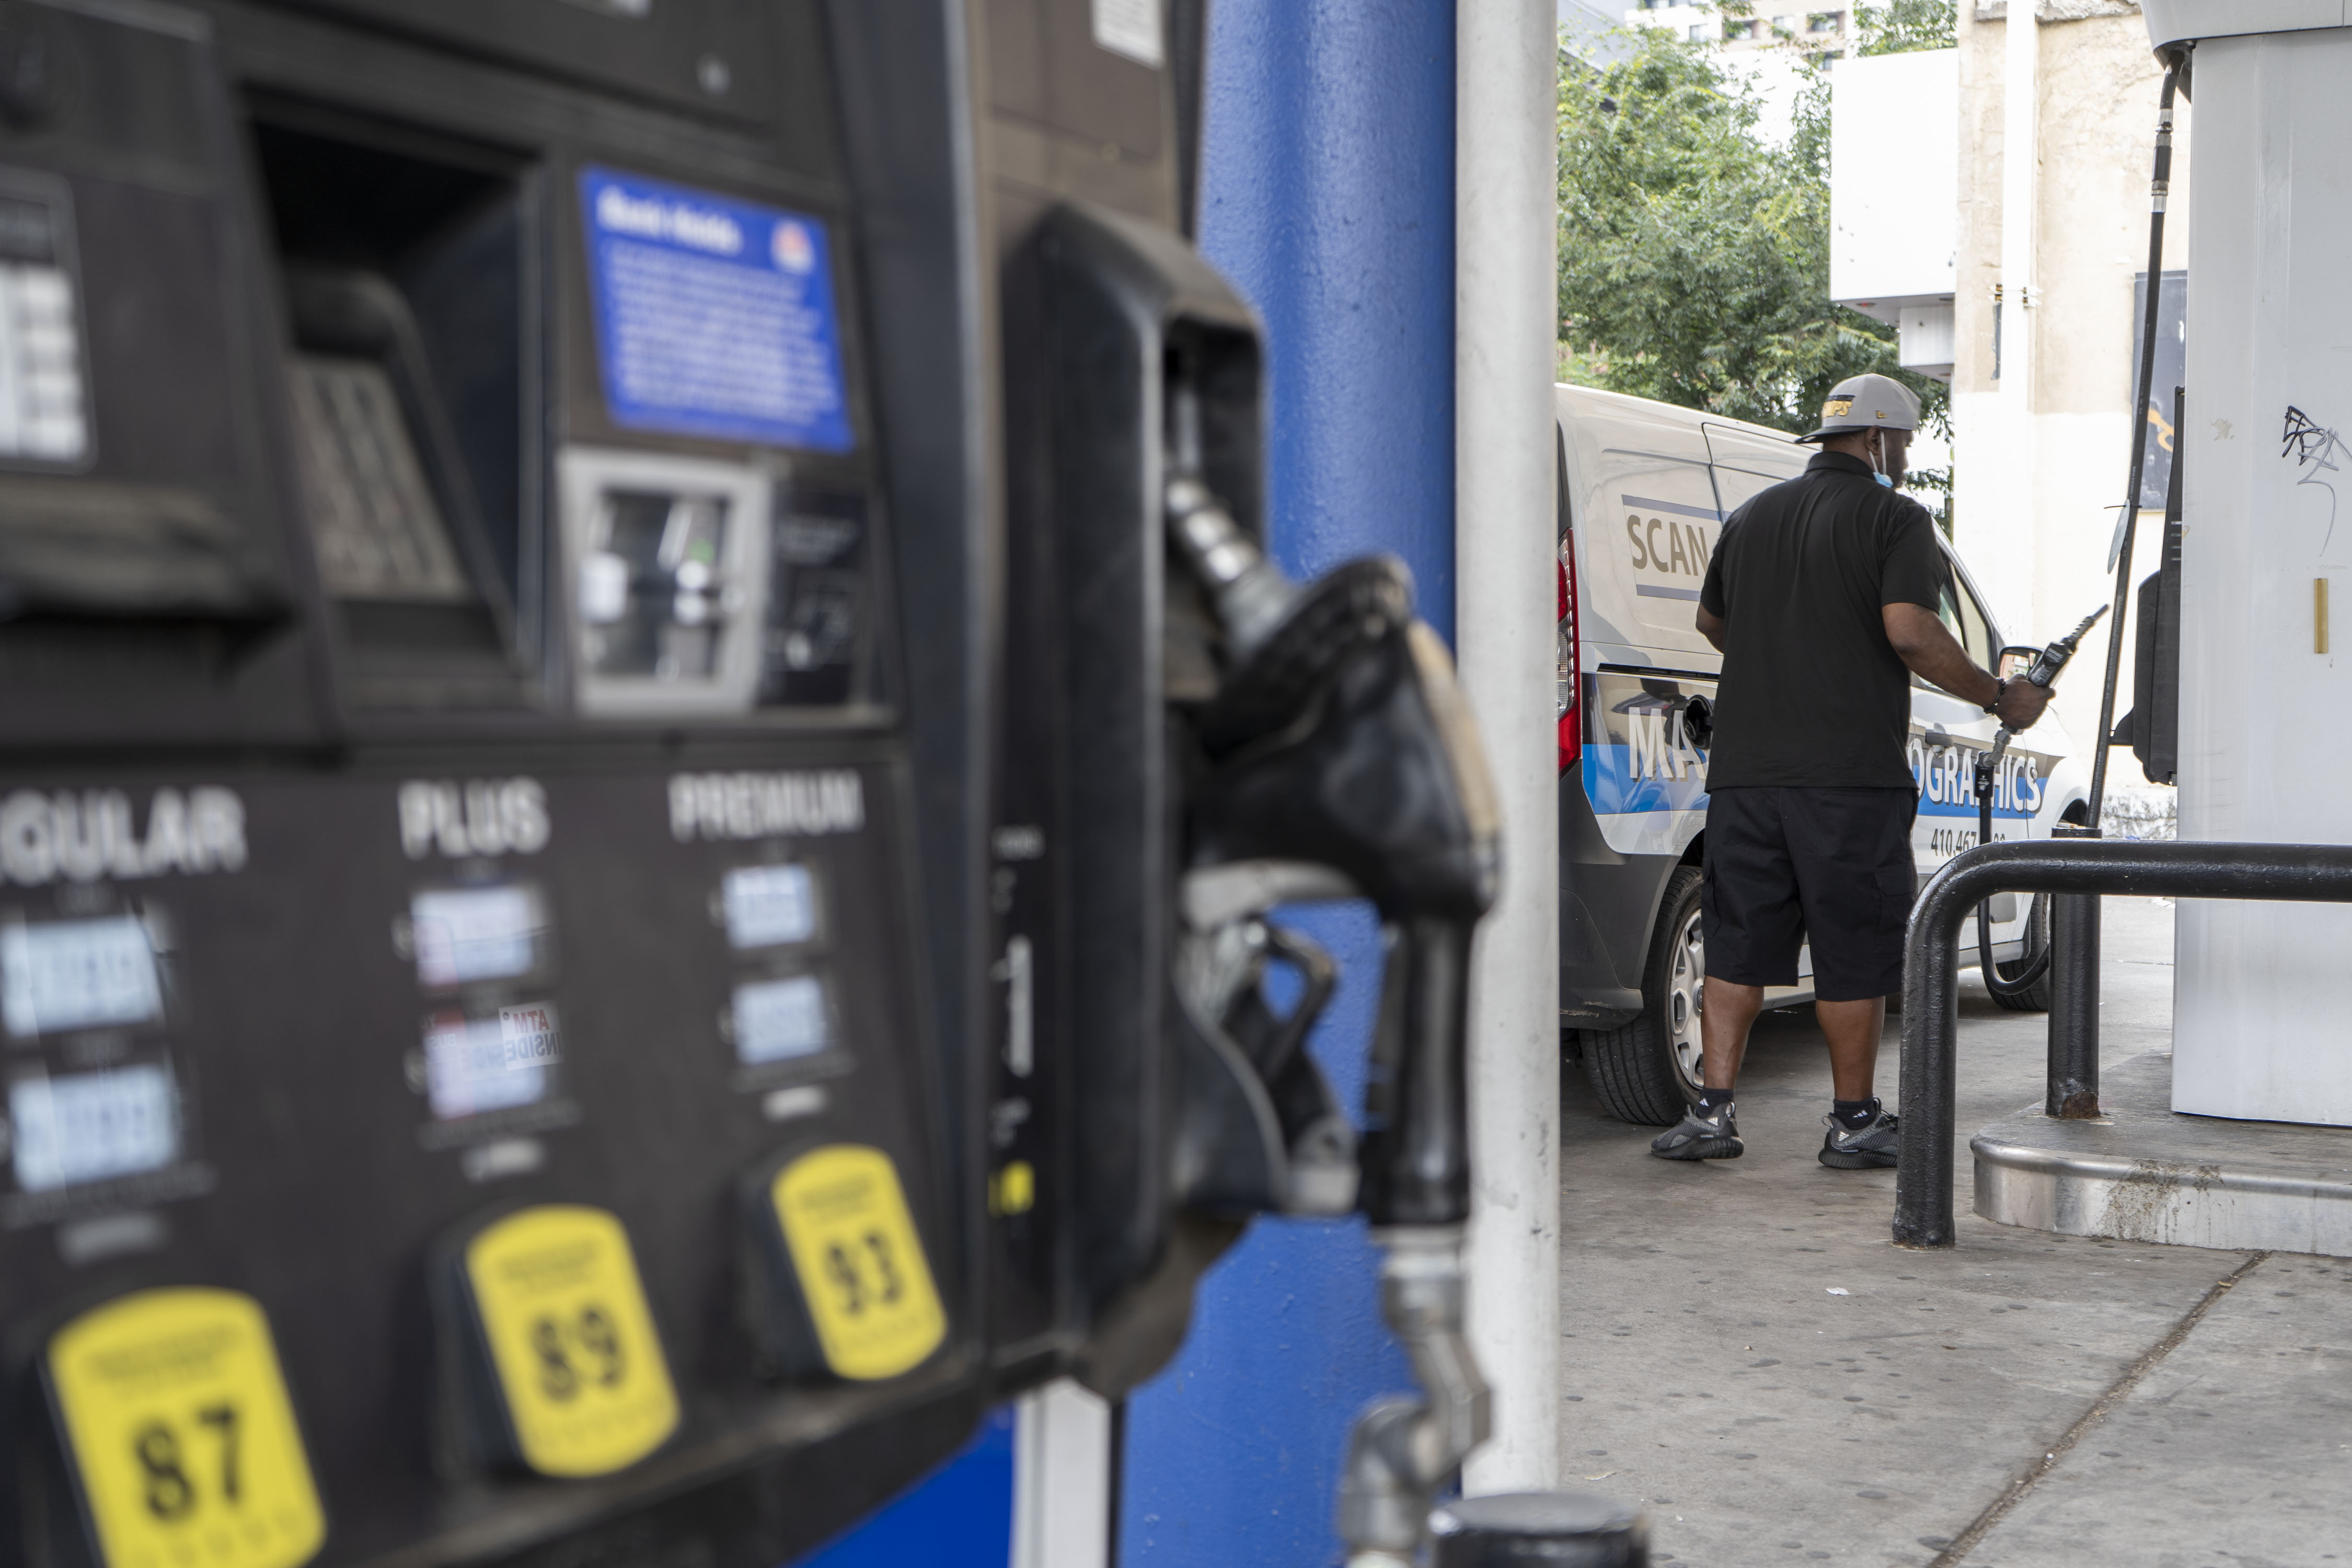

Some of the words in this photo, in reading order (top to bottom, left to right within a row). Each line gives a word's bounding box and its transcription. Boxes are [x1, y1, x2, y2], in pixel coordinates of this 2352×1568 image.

[1627, 514, 1709, 577] SCAN
[1629, 707, 1707, 782] MA
[1908, 738, 2042, 812] OGRAHICS
[0, 785, 249, 883] GULAR
[396, 776, 551, 860] PLUS
[668, 769, 866, 843] PREMIUM
[129, 1397, 246, 1525] 87
